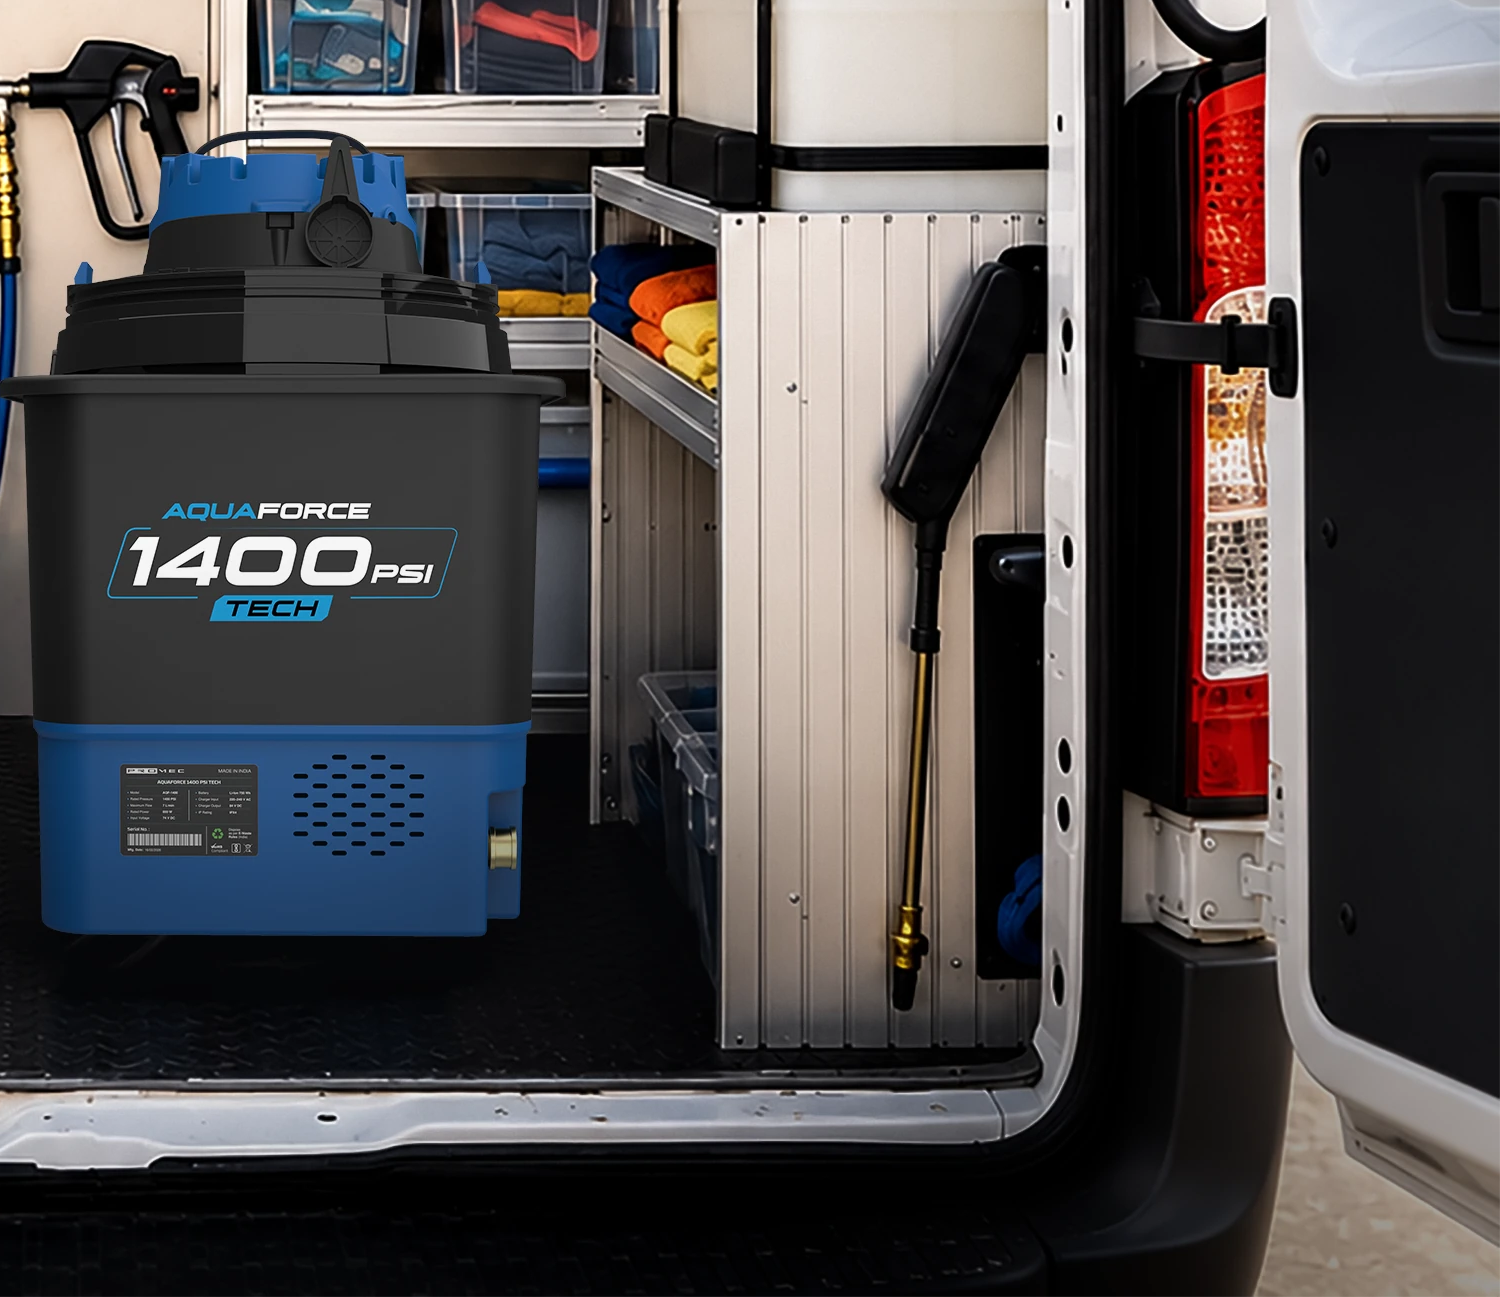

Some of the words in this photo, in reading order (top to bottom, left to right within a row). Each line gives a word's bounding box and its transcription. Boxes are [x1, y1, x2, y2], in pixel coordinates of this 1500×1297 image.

[161, 502, 372, 522] AQUAFORCE
[129, 536, 373, 587] 1400
[370, 564, 435, 584] PSI
[226, 600, 319, 617] TECH
